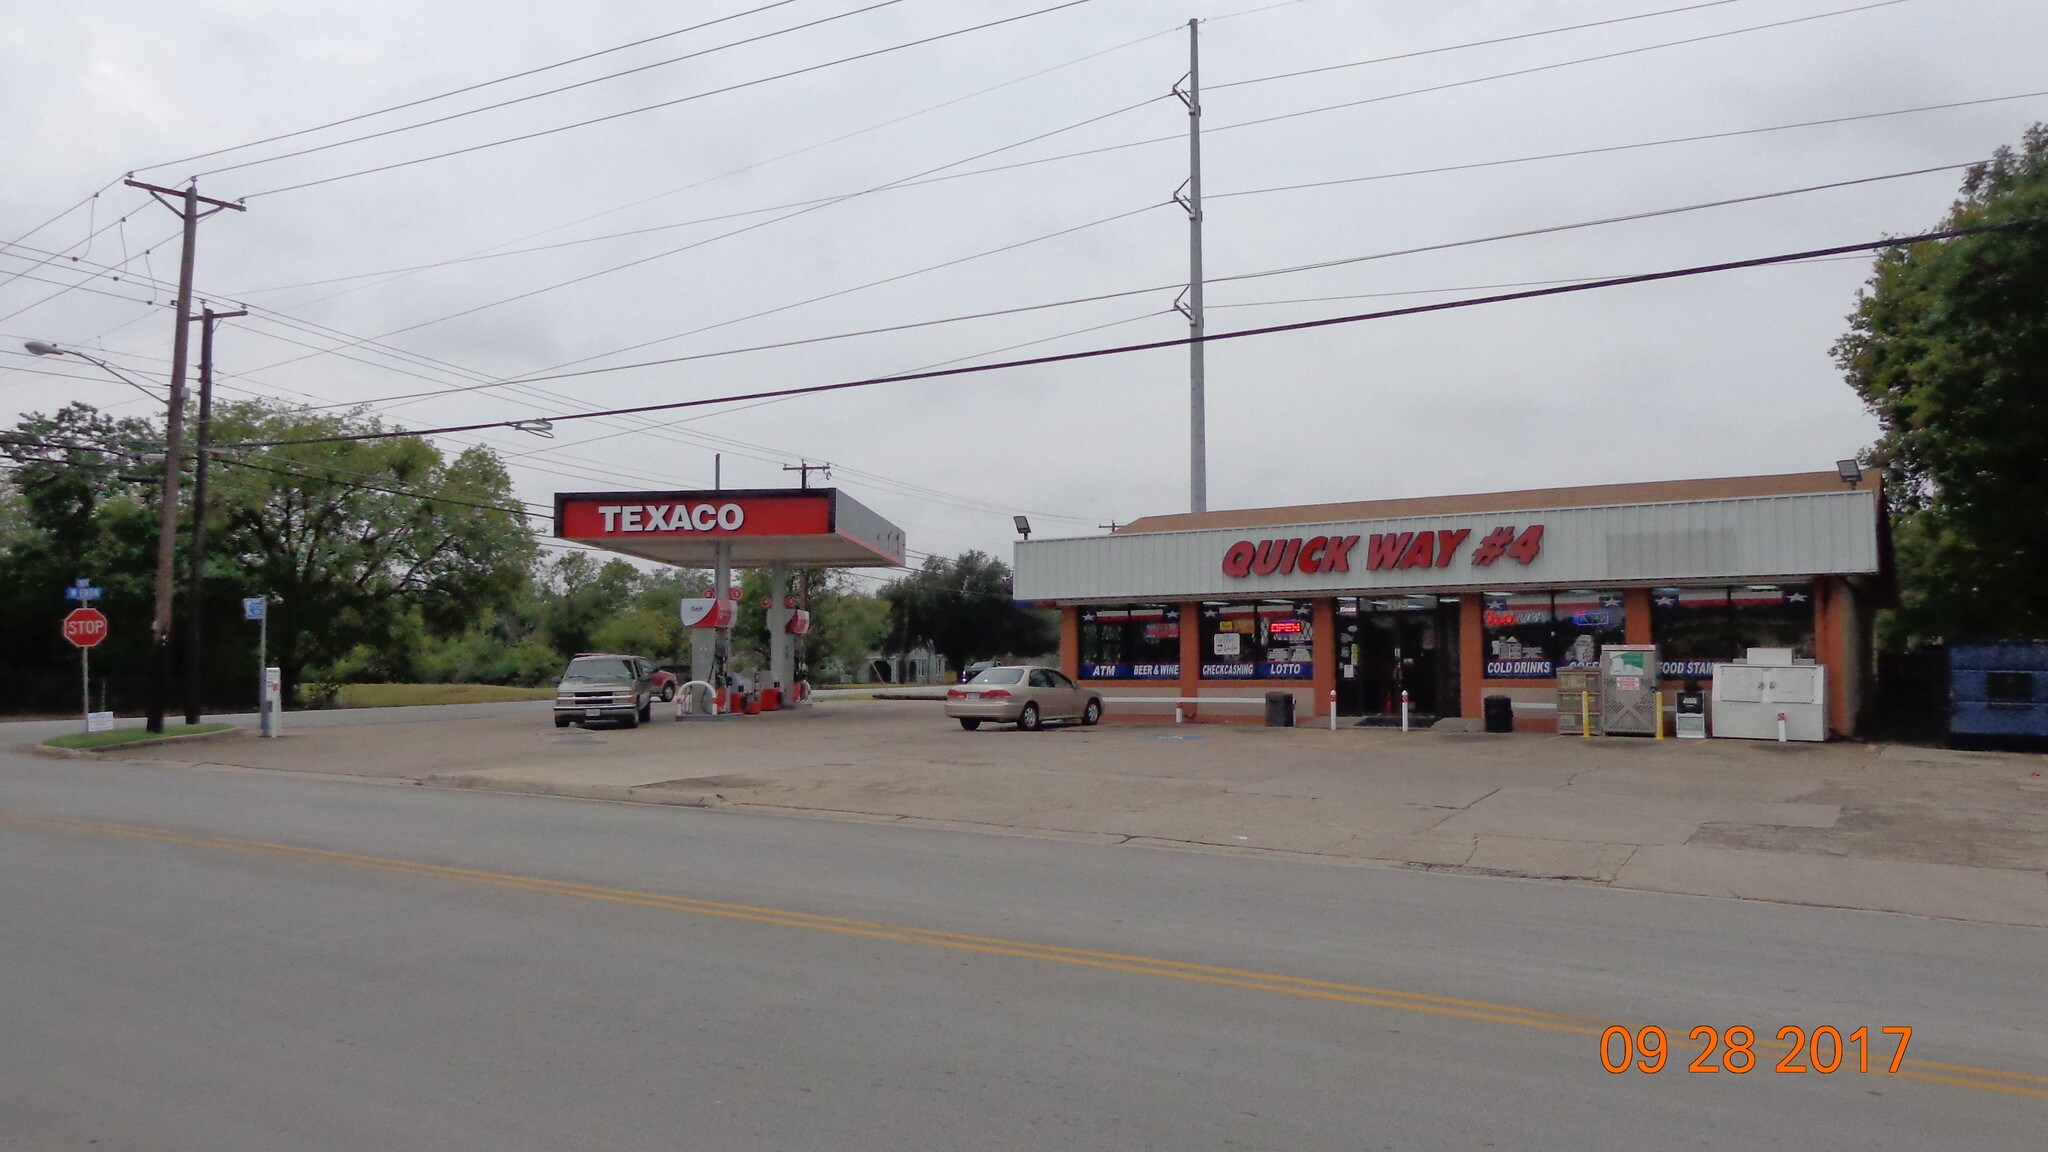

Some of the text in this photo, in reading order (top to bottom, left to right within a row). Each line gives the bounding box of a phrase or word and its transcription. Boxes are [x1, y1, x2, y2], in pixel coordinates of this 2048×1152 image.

[598, 503, 744, 532] TEXACO
[1222, 525, 1545, 579] QUICK WAY #4
[68, 620, 104, 635] STOP
[1092, 665, 1116, 676] ATM
[1133, 664, 1179, 676] BEER & WINE
[1270, 663, 1301, 675] LOTTO
[1487, 661, 1550, 674] COLD DRINKS
[1657, 662, 1715, 674] FOOD STAM
